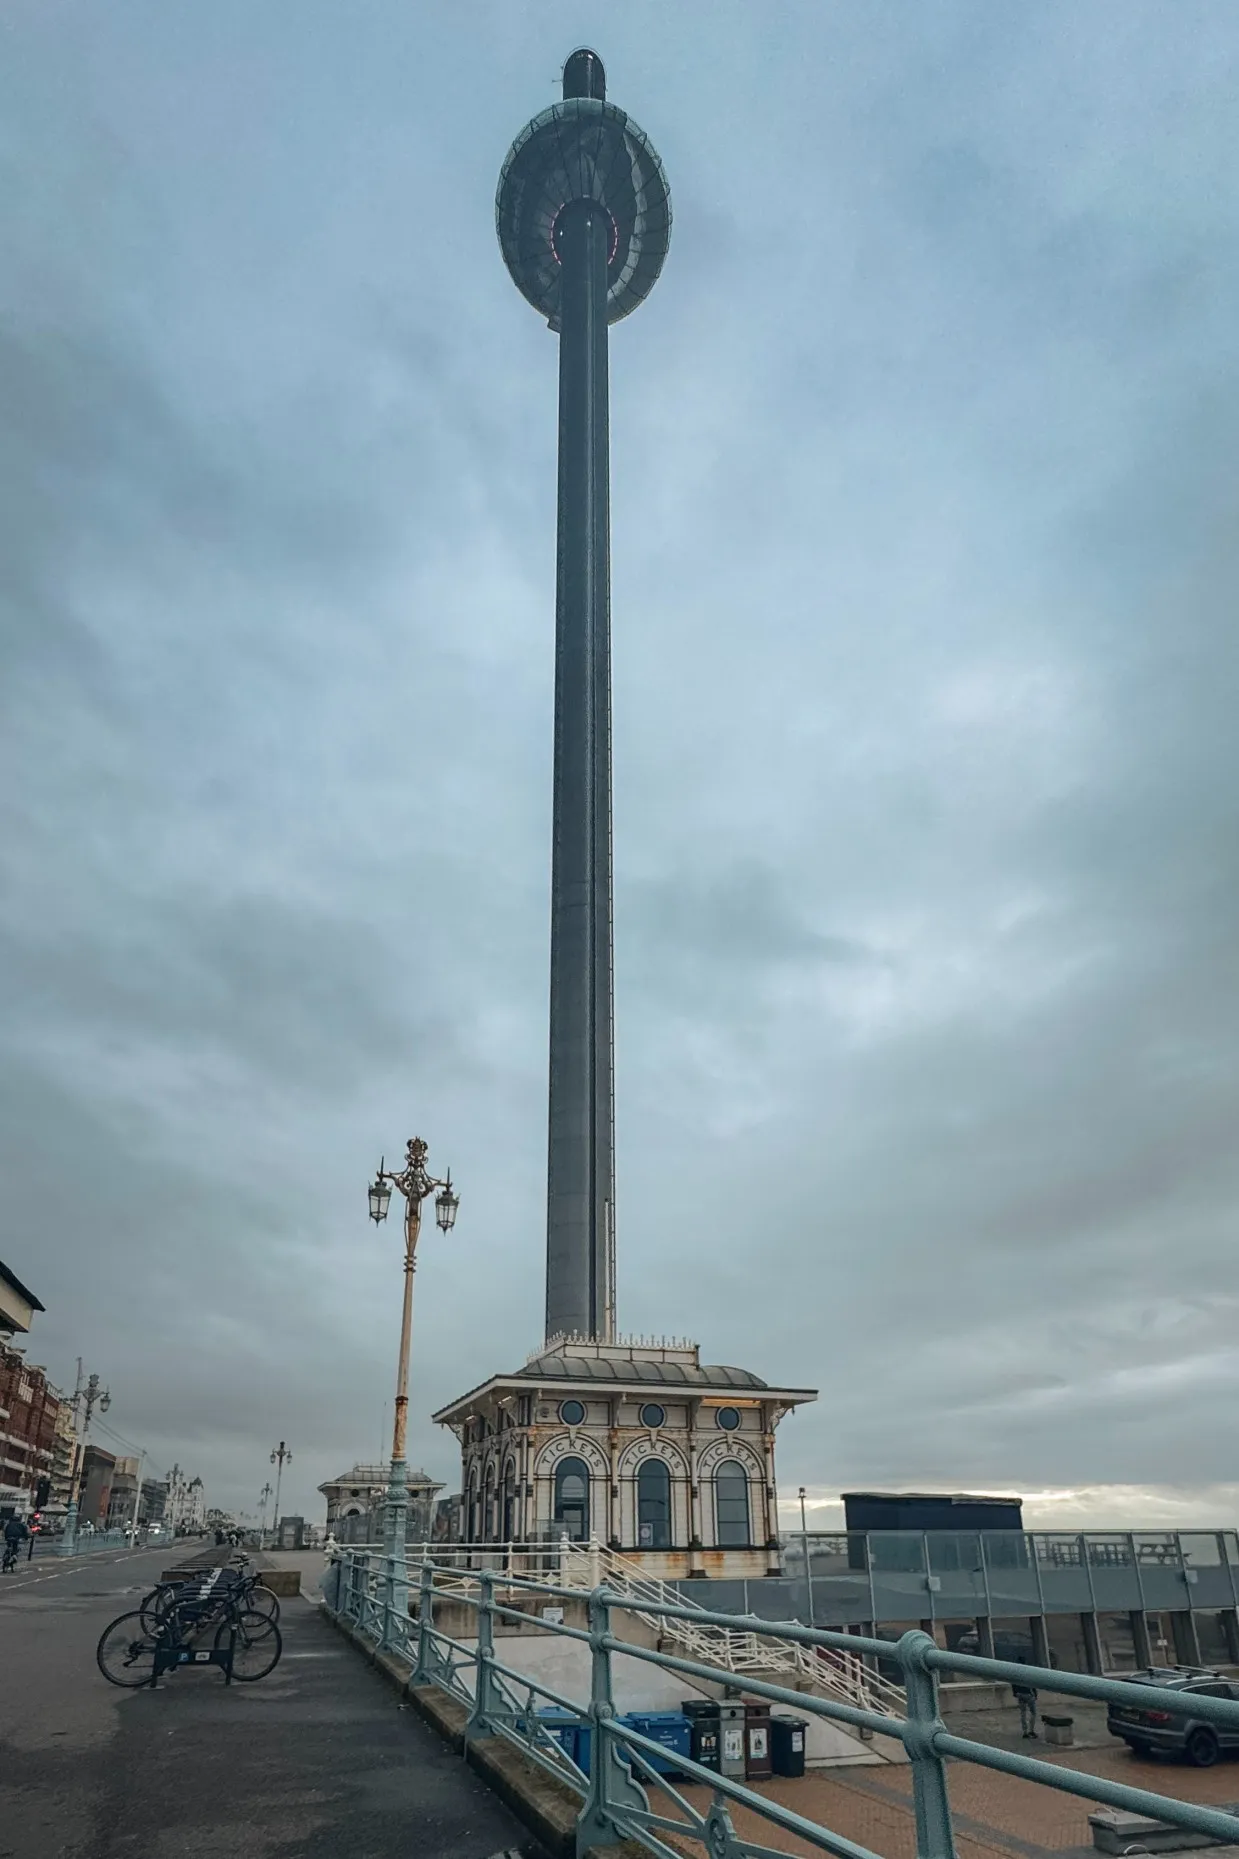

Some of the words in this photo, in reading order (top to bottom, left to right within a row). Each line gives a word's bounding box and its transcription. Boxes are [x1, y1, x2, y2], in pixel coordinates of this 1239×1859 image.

[541, 1440, 602, 1467] TICKETS
[625, 1441, 682, 1469] TICKETS
[703, 1444, 757, 1470] TICKETS
